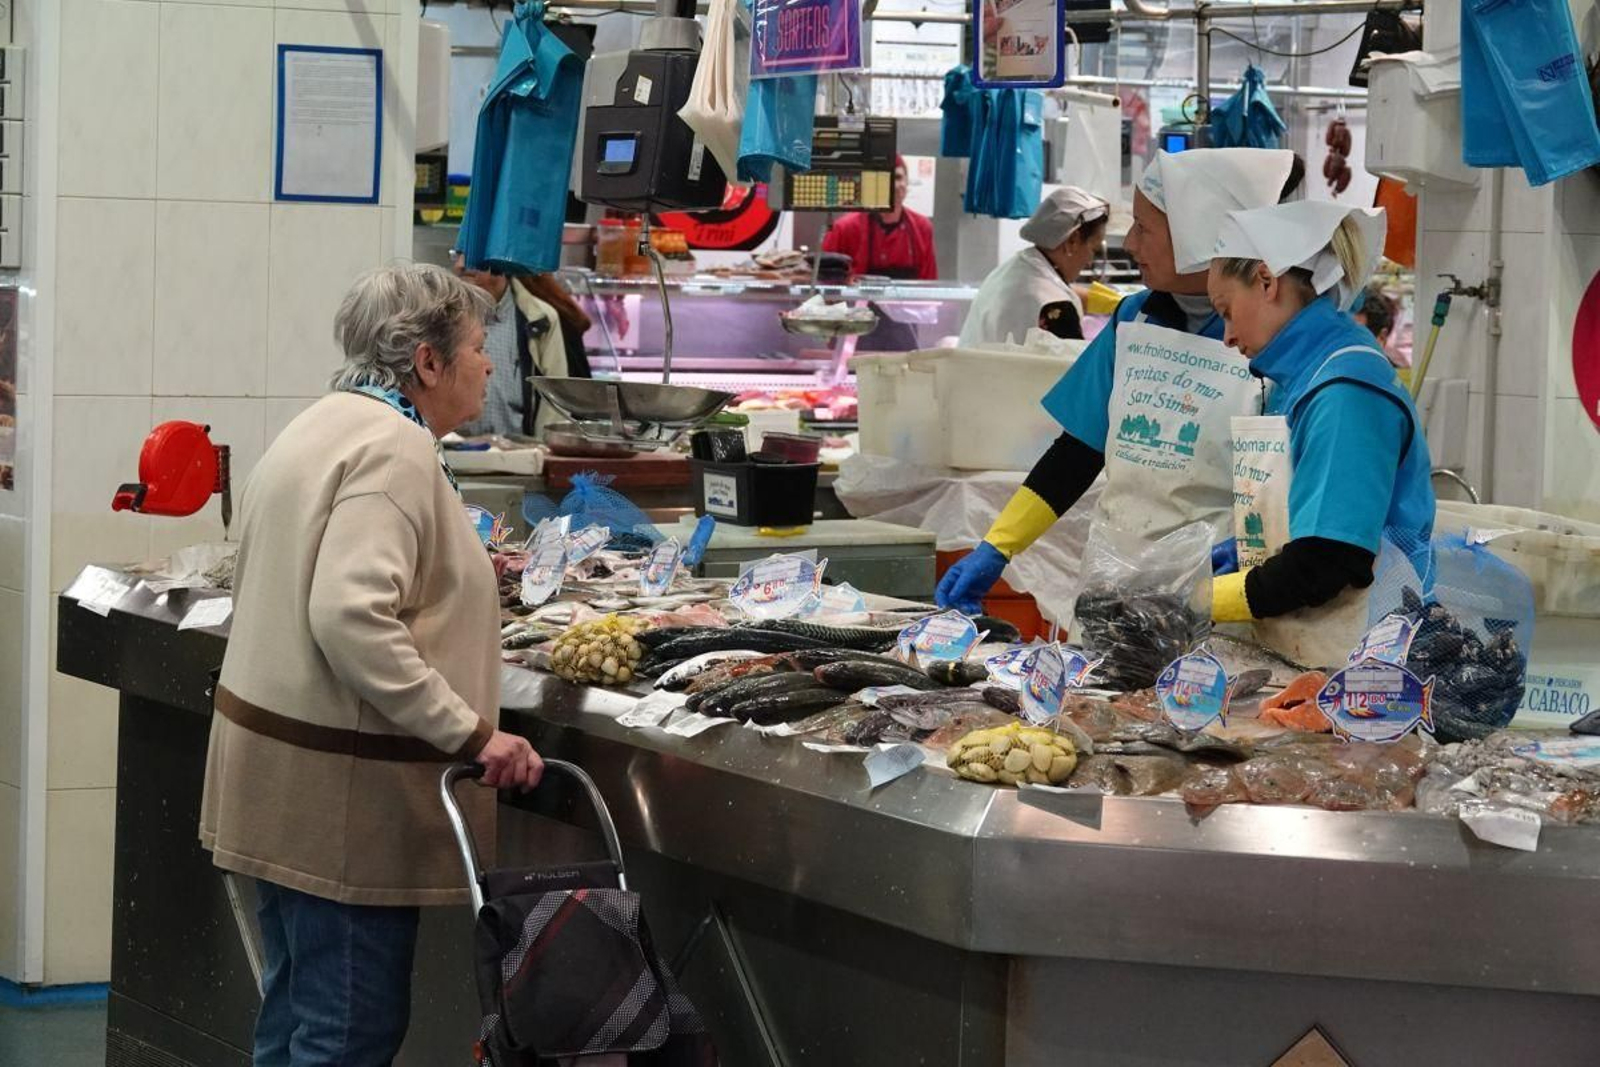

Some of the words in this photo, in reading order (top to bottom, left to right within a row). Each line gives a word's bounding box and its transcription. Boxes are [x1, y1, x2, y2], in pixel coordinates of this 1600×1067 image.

[777, 5, 830, 52] SORTEOS
[1127, 388, 1153, 407] San
[1172, 368, 1203, 389] do
[1195, 382, 1224, 400] mar
[1249, 468, 1272, 484] mar
[1528, 687, 1590, 716] CABACO
